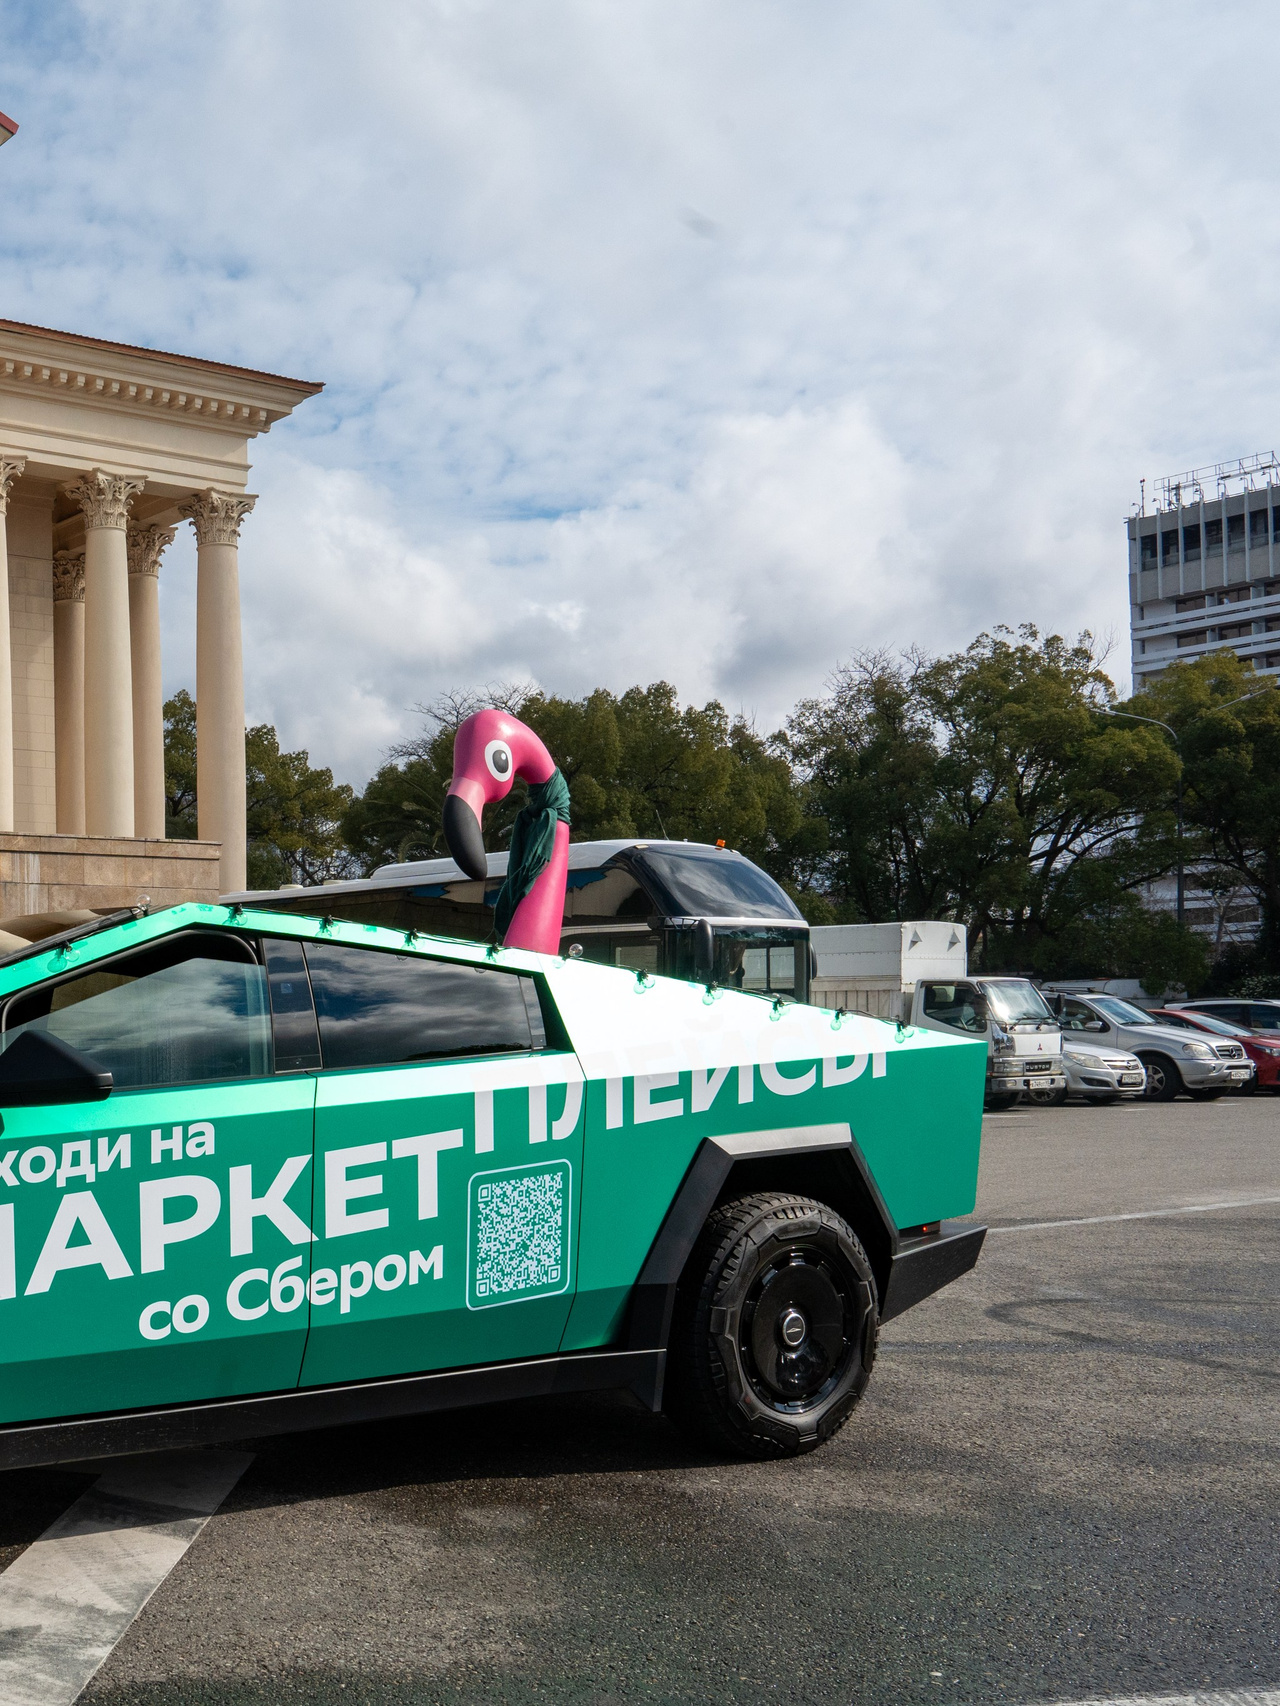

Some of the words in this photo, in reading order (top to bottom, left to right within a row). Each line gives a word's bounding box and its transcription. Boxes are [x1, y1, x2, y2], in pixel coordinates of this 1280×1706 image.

[150, 1121, 216, 1164] на
[138, 1292, 209, 1340] со
[226, 1243, 444, 1321] Сбером
